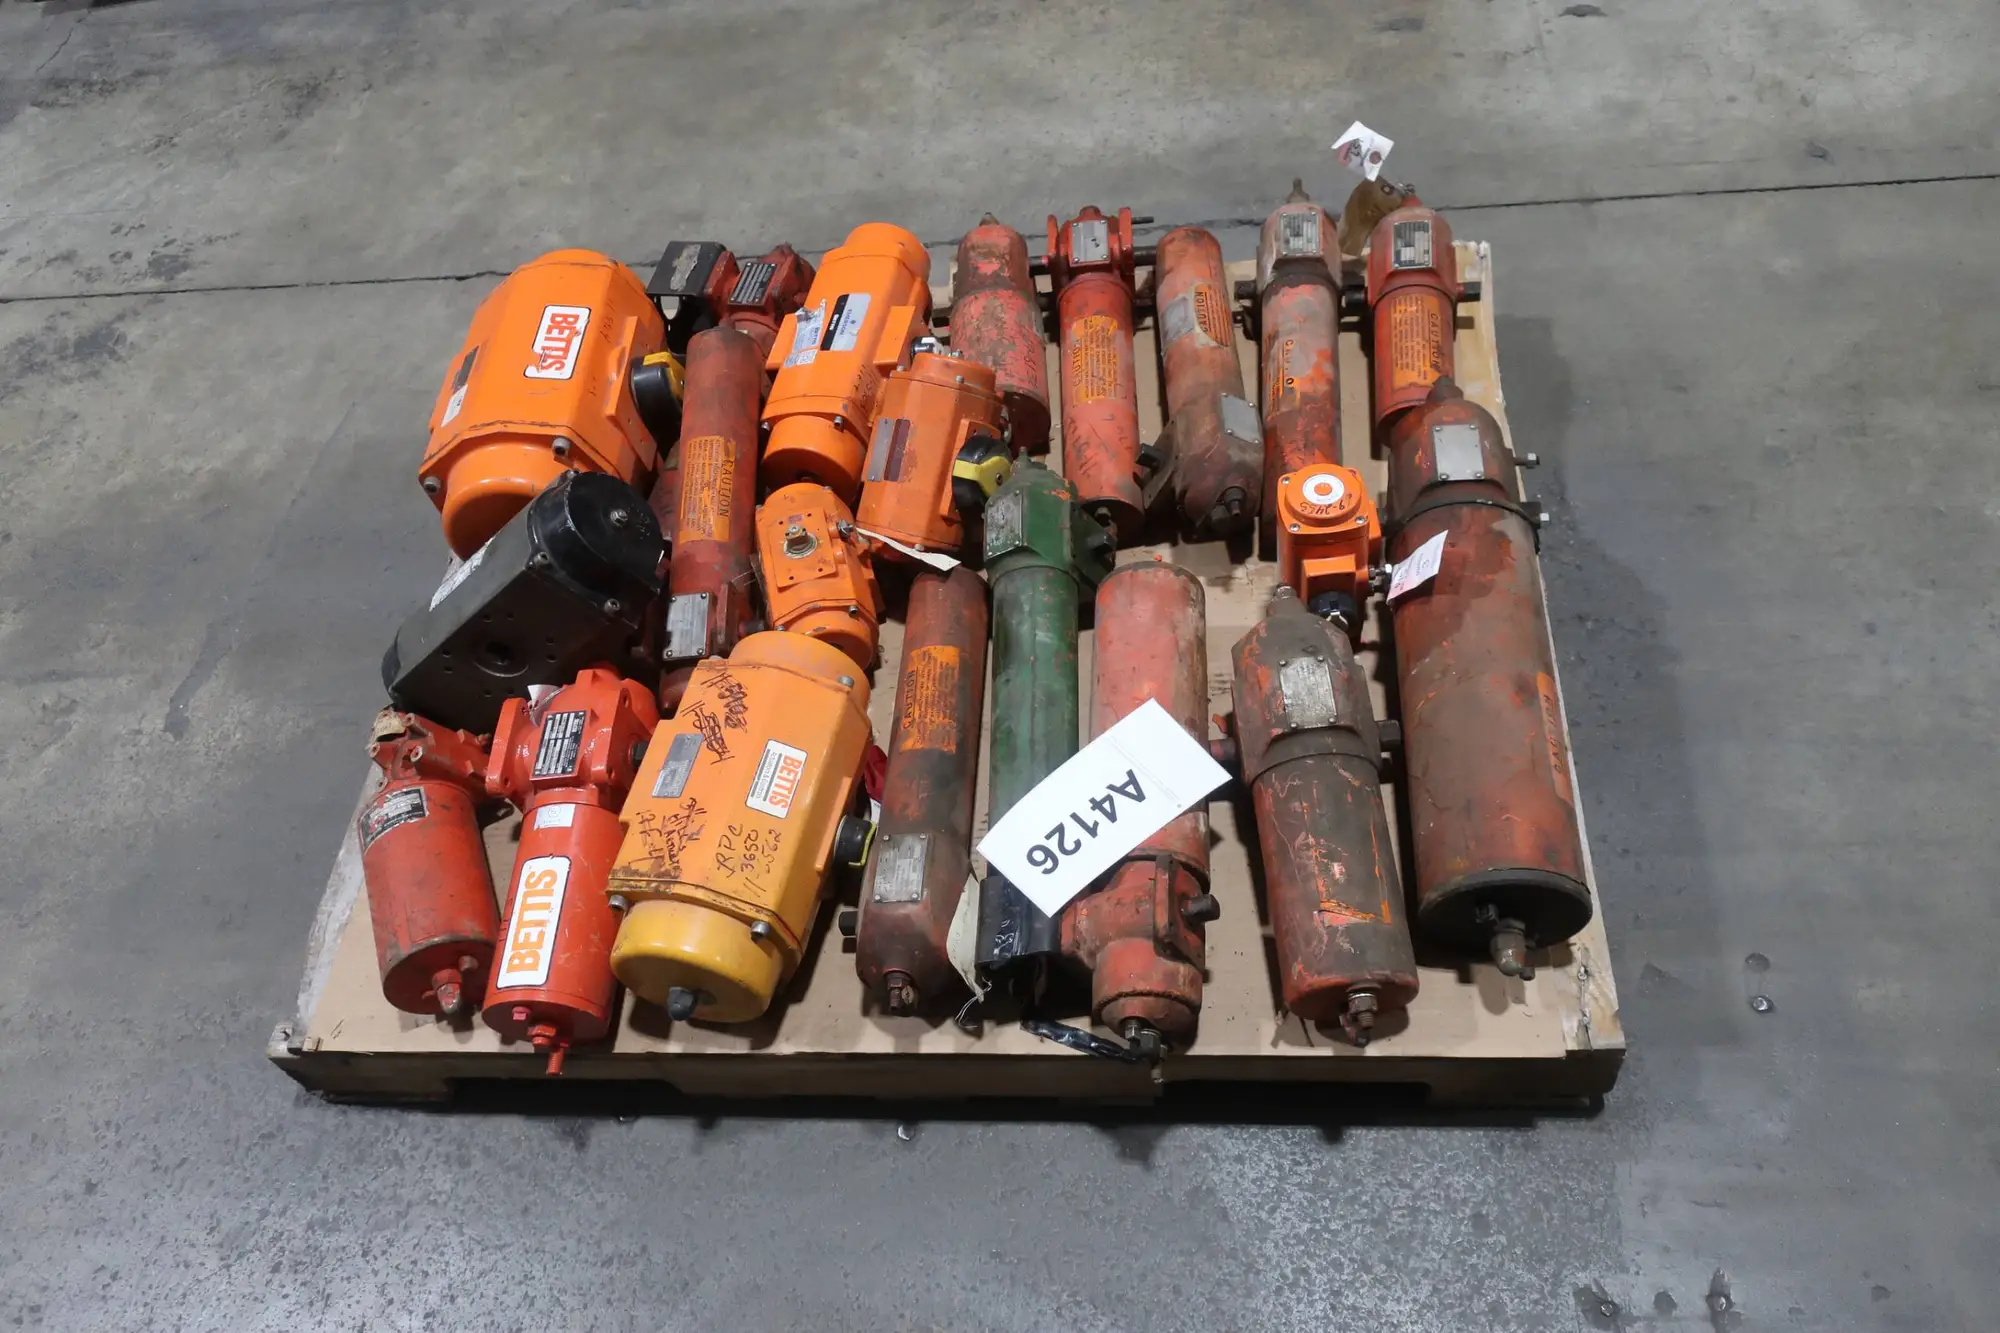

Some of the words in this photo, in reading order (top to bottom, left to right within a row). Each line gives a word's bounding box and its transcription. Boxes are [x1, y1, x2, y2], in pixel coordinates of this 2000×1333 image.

[840, 309, 852, 335] EMERSON
[1195, 291, 1209, 332] CAUTION
[539, 313, 580, 372] BETTIS
[719, 459, 734, 518] CAUTION
[768, 755, 803, 809] BETTIS
[1026, 769, 1146, 875] A4126
[740, 829, 760, 872] 3650
[505, 868, 558, 974] BETTIS
